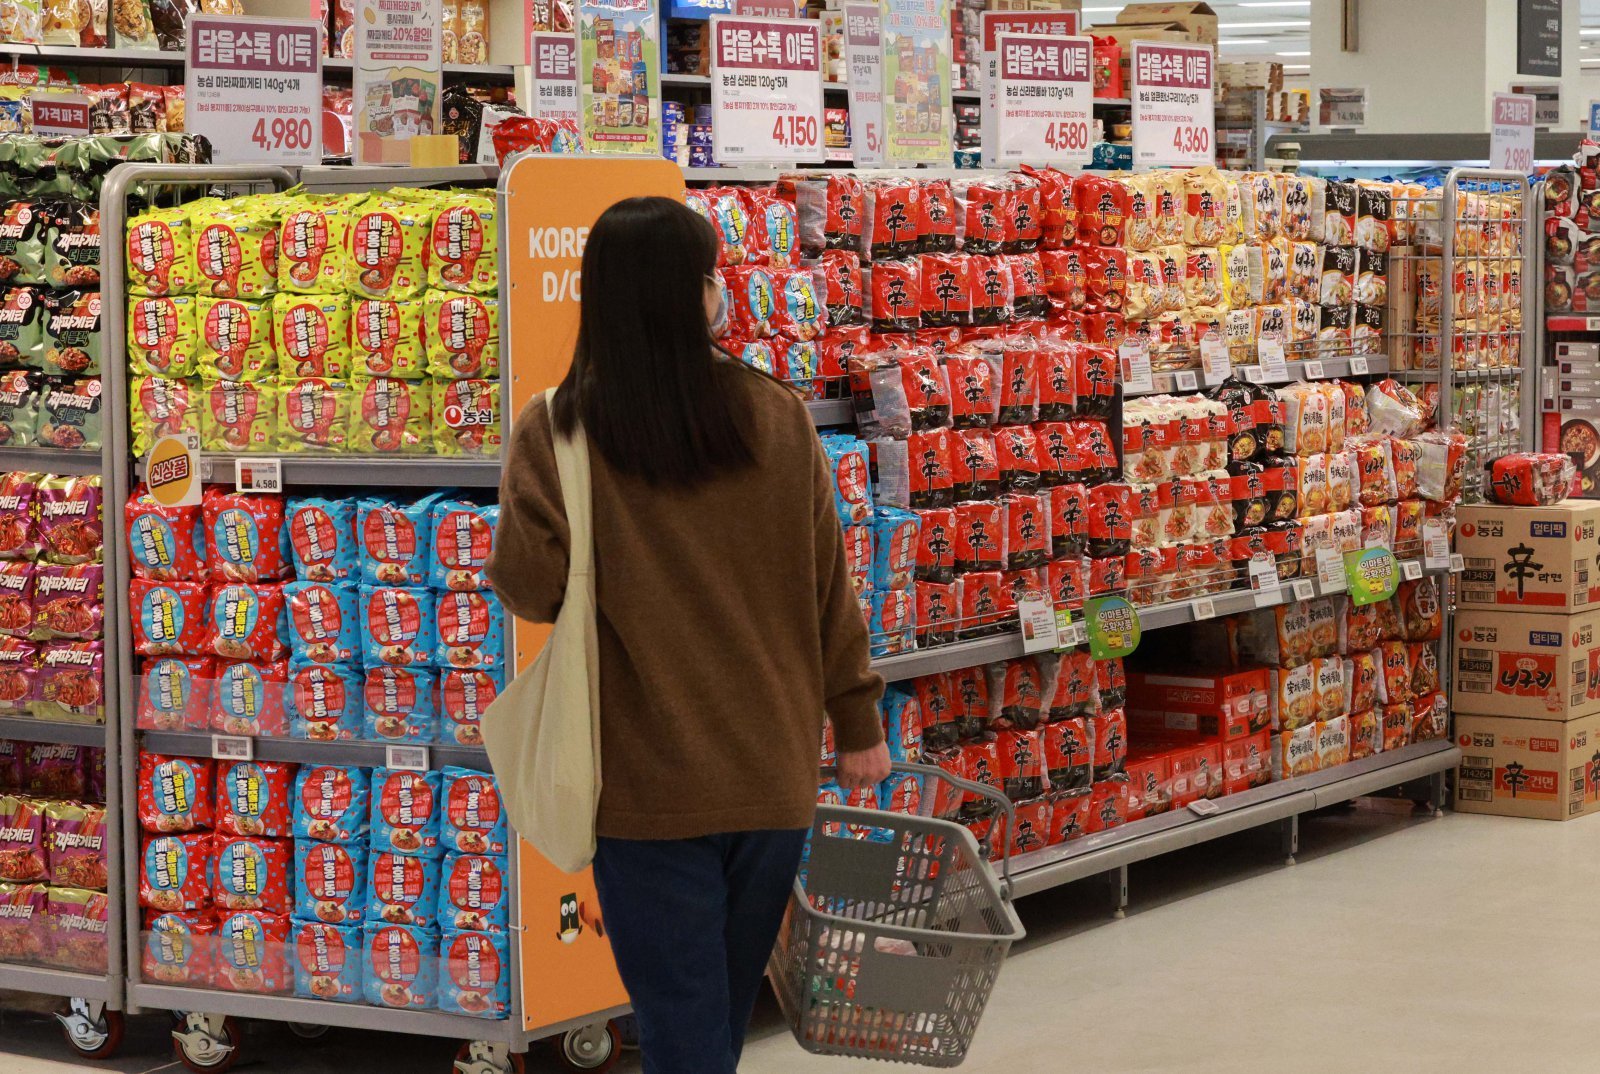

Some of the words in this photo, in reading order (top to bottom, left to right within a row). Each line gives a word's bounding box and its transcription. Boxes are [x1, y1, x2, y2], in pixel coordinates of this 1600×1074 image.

[199, 30, 271, 65] 담을수록
[277, 34, 312, 66] 이득
[367, 29, 392, 40] 짜파게티
[722, 30, 782, 64] 담을수록
[786, 33, 814, 66] 이득
[1006, 44, 1058, 76] 담을수록
[1062, 48, 1088, 76] 이득
[1139, 53, 1184, 82] 담을수록
[1186, 56, 1207, 84] 이득
[197, 75, 214, 88] 농심
[216, 76, 262, 90] 마라짜파게티
[540, 86, 552, 96] 농심
[723, 74, 736, 86] 농심
[738, 76, 756, 87] 신라면
[1006, 86, 1018, 96] 농심
[1020, 86, 1047, 98] 신라면툼바
[1140, 91, 1150, 102] 농심
[38, 107, 84, 124] 가격파격
[252, 118, 312, 150] 4,980
[773, 116, 818, 148] 4,150
[1045, 122, 1088, 150] 4,580
[1174, 126, 1208, 153] 4,360
[139, 223, 155, 272] 배홍동
[151, 226, 162, 262] 칼빔면
[219, 231, 231, 267] 칼빔면
[367, 216, 381, 265] 배홍동
[381, 221, 392, 257] 칼빔면
[449, 209, 462, 259] 배홍동
[461, 215, 473, 251] 칼빔면
[208, 228, 223, 276] 배홍동
[50, 316, 98, 334] 짜파게티
[218, 304, 230, 351] 배홍동
[229, 308, 241, 343] 칼빔면
[369, 301, 380, 348] 배홍동
[380, 303, 390, 339] 칼빔면
[451, 299, 465, 349] 배홍동
[464, 303, 477, 340] 칼빔면
[48, 391, 94, 410] 짜파게티
[463, 408, 492, 424] 농심
[150, 456, 188, 483] 신상품
[256, 479, 277, 490] 4.580
[42, 500, 88, 520] 짜파게티
[138, 515, 159, 565] 배홍동
[223, 512, 240, 561] 배홍동
[457, 515, 471, 566] 배홍동
[1478, 526, 1503, 537] 농심
[1534, 523, 1564, 536] 멀티팩
[38, 575, 90, 596] 짜파게티
[1363, 566, 1392, 580] 수확상품
[1504, 543, 1544, 600] 辛
[1538, 573, 1562, 583] 라면
[225, 588, 238, 636] 배홍동
[383, 591, 402, 641] 배홍동
[455, 592, 471, 643] 배홍동
[1102, 620, 1132, 633] 수확상품
[1474, 632, 1497, 643] 농심
[1532, 633, 1559, 645] 멀티팩
[1580, 632, 1592, 645] 농심
[46, 649, 95, 668] 짜파게티
[1501, 668, 1554, 690] 너구리
[1473, 736, 1494, 746] 농심
[1531, 739, 1558, 751] 멀티팩
[160, 762, 177, 812] 배홍동
[1504, 760, 1530, 799] 辛
[1530, 776, 1554, 789] 건면
[399, 775, 413, 824] 배홍동
[466, 779, 481, 827] 배홍동
[56, 832, 102, 852] 짜파게티
[322, 847, 336, 897] 배홍동
[466, 937, 481, 986] 배홍동
